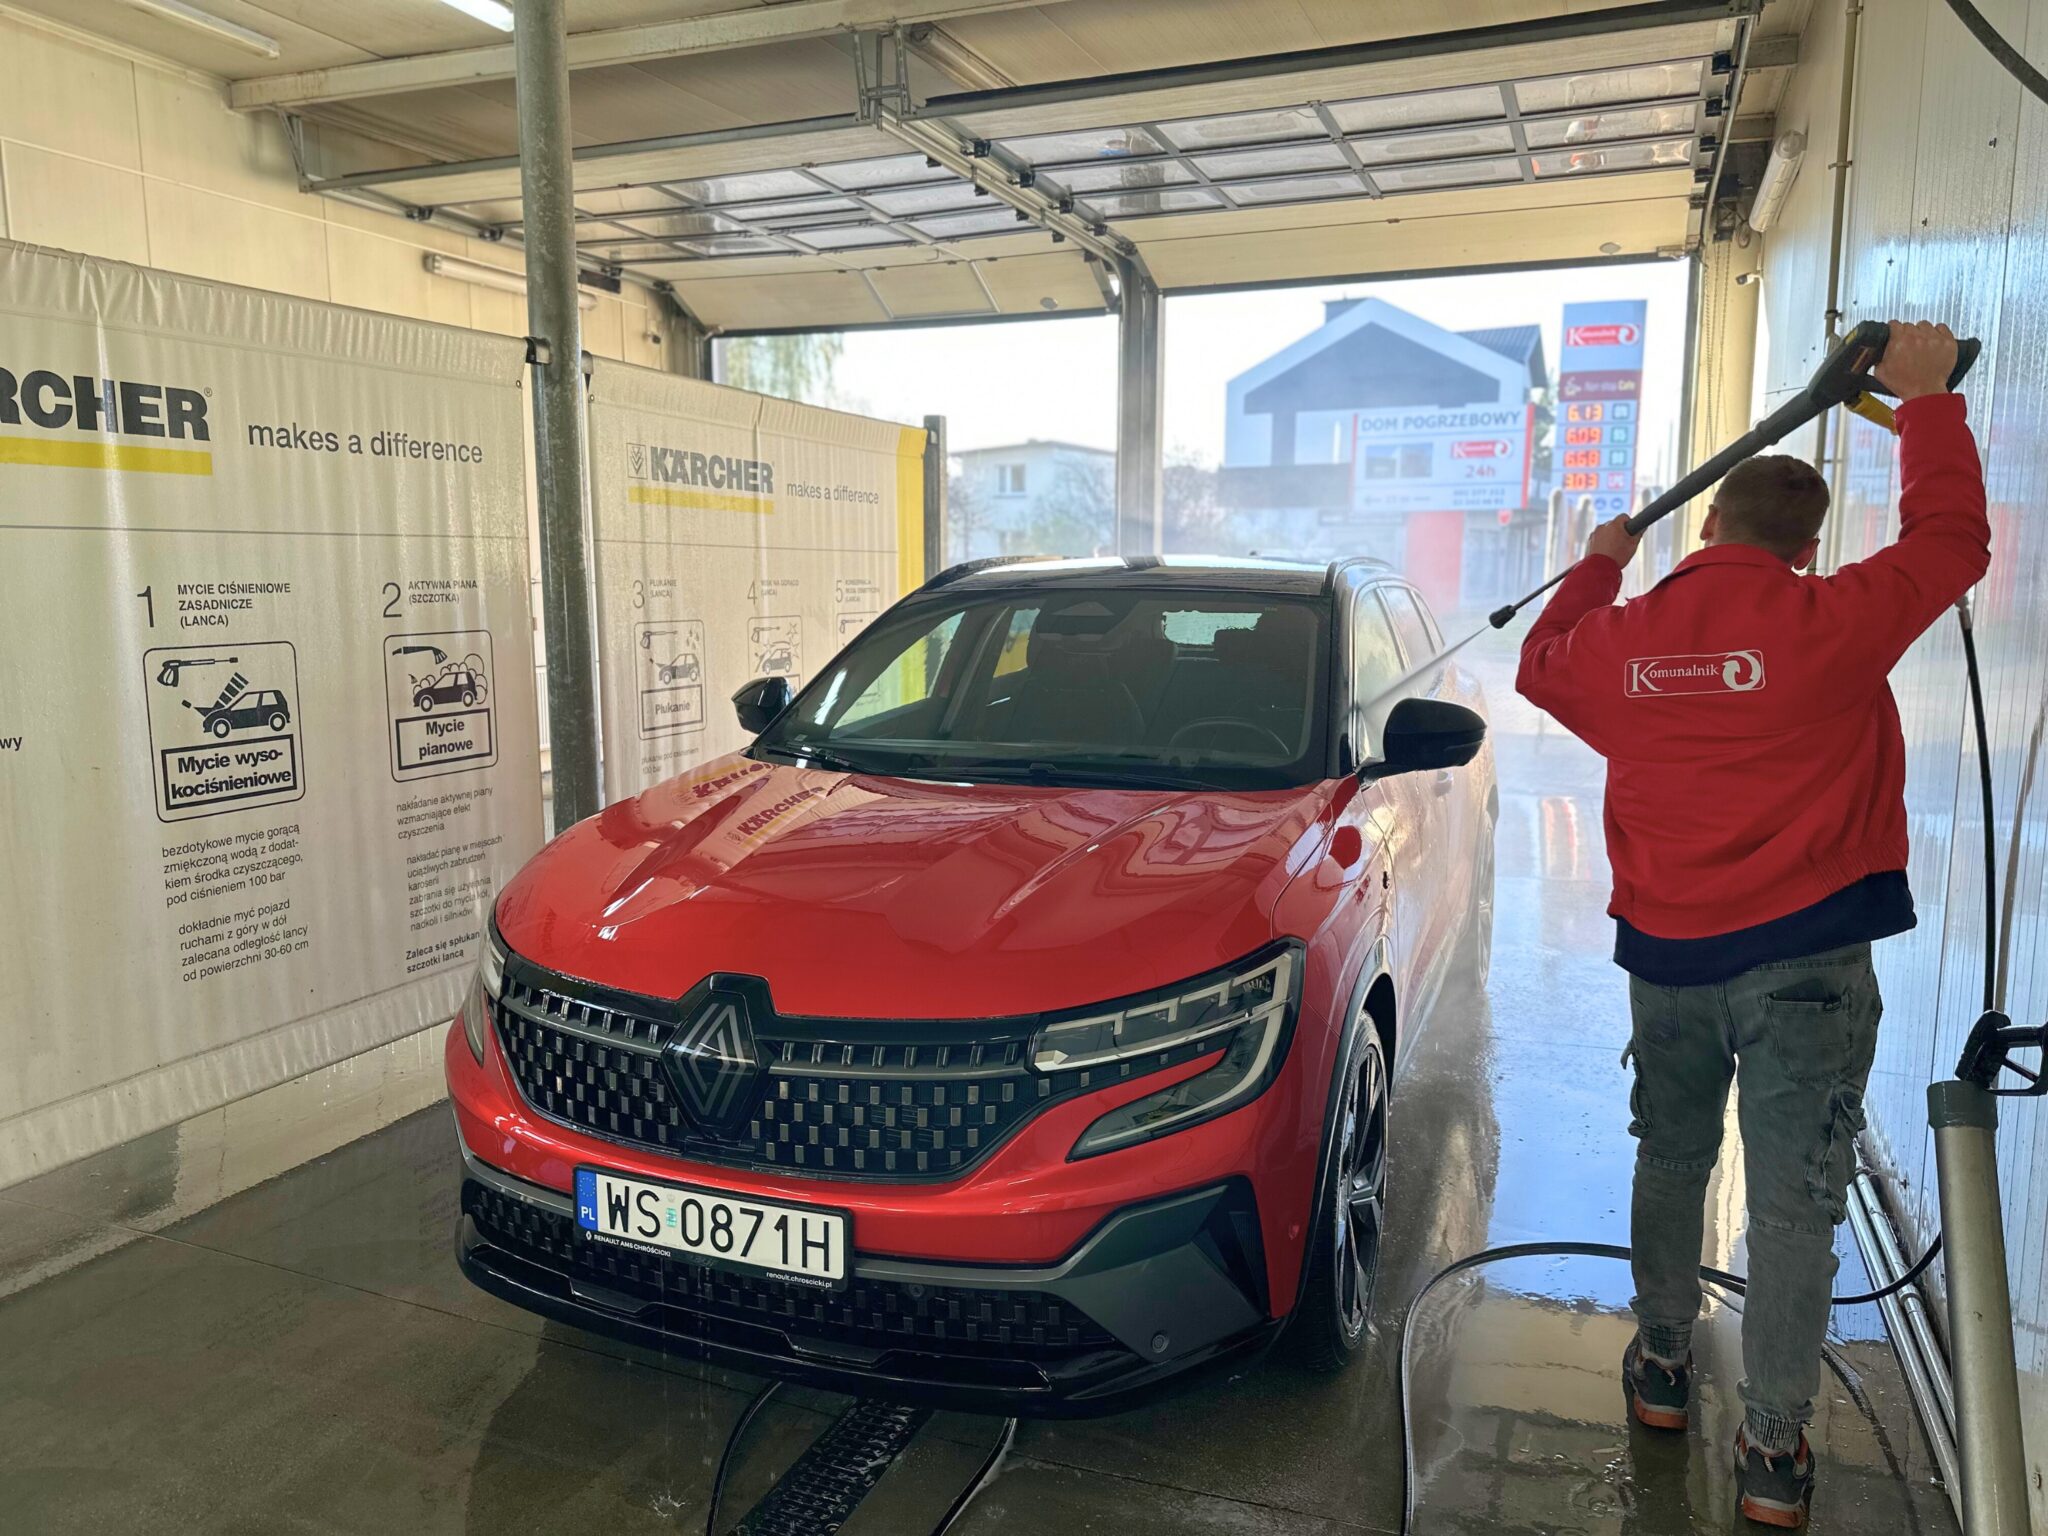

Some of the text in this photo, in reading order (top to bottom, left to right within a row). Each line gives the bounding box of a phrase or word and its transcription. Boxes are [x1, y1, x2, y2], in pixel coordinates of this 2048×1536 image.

[1361, 411, 1521, 432] DOM POGRZEBOWY
[248, 422, 483, 464] makes a difference
[650, 446, 774, 494] KÄRCHER
[786, 480, 879, 504] makes a difference
[178, 581, 291, 595] MYCIE CIŚNIENIOWE
[408, 579, 478, 590] AKTYWNA PIANA
[632, 579, 645, 609] 3
[747, 580, 757, 605] 4
[836, 579, 843, 603] 5
[137, 585, 154, 628] 1
[179, 599, 253, 611] ZASADNICZE
[382, 582, 402, 618] 2
[409, 593, 460, 605] (SZCZOTKA)
[180, 615, 229, 628] (LANCA)
[1629, 661, 1720, 693] Komunalnik
[426, 719, 465, 737] Mycie
[419, 737, 473, 760] pianowe
[178, 749, 283, 775] Mycie wyso-
[171, 770, 291, 799] kociśnieniowe
[396, 786, 493, 812] nakładanie aktywnej piany
[397, 803, 471, 826] wzmacniające efekt
[162, 824, 300, 858] bezdotykowe mycie gorącą
[398, 822, 445, 840] czyszczenia
[163, 838, 299, 874] zmiękczoną wodą z dodat-
[406, 834, 503, 865] nakładać pianę w miejscach
[450, 850, 486, 868] zabrudzeń
[165, 853, 303, 890] kiem środka czyszczącego,
[166, 871, 286, 908] pod ciśnieniem 100 bar
[409, 889, 442, 905] zabrania
[444, 886, 456, 895] się
[178, 898, 290, 935] dokładnie myć pojazd
[409, 904, 441, 918] szczotki
[443, 900, 453, 909] do
[180, 914, 287, 951] ruchami z góry w dół
[181, 924, 309, 967] zalecana odległość lancy
[405, 945, 434, 960] Zaleca
[435, 941, 447, 951] się
[183, 940, 309, 982] od powierzchni 30-60 cm
[406, 949, 464, 973] szczotki lancą
[581, 1206, 596, 1221] PL
[606, 1182, 830, 1272] WS 0871H
[593, 1234, 620, 1246] RENAULT
